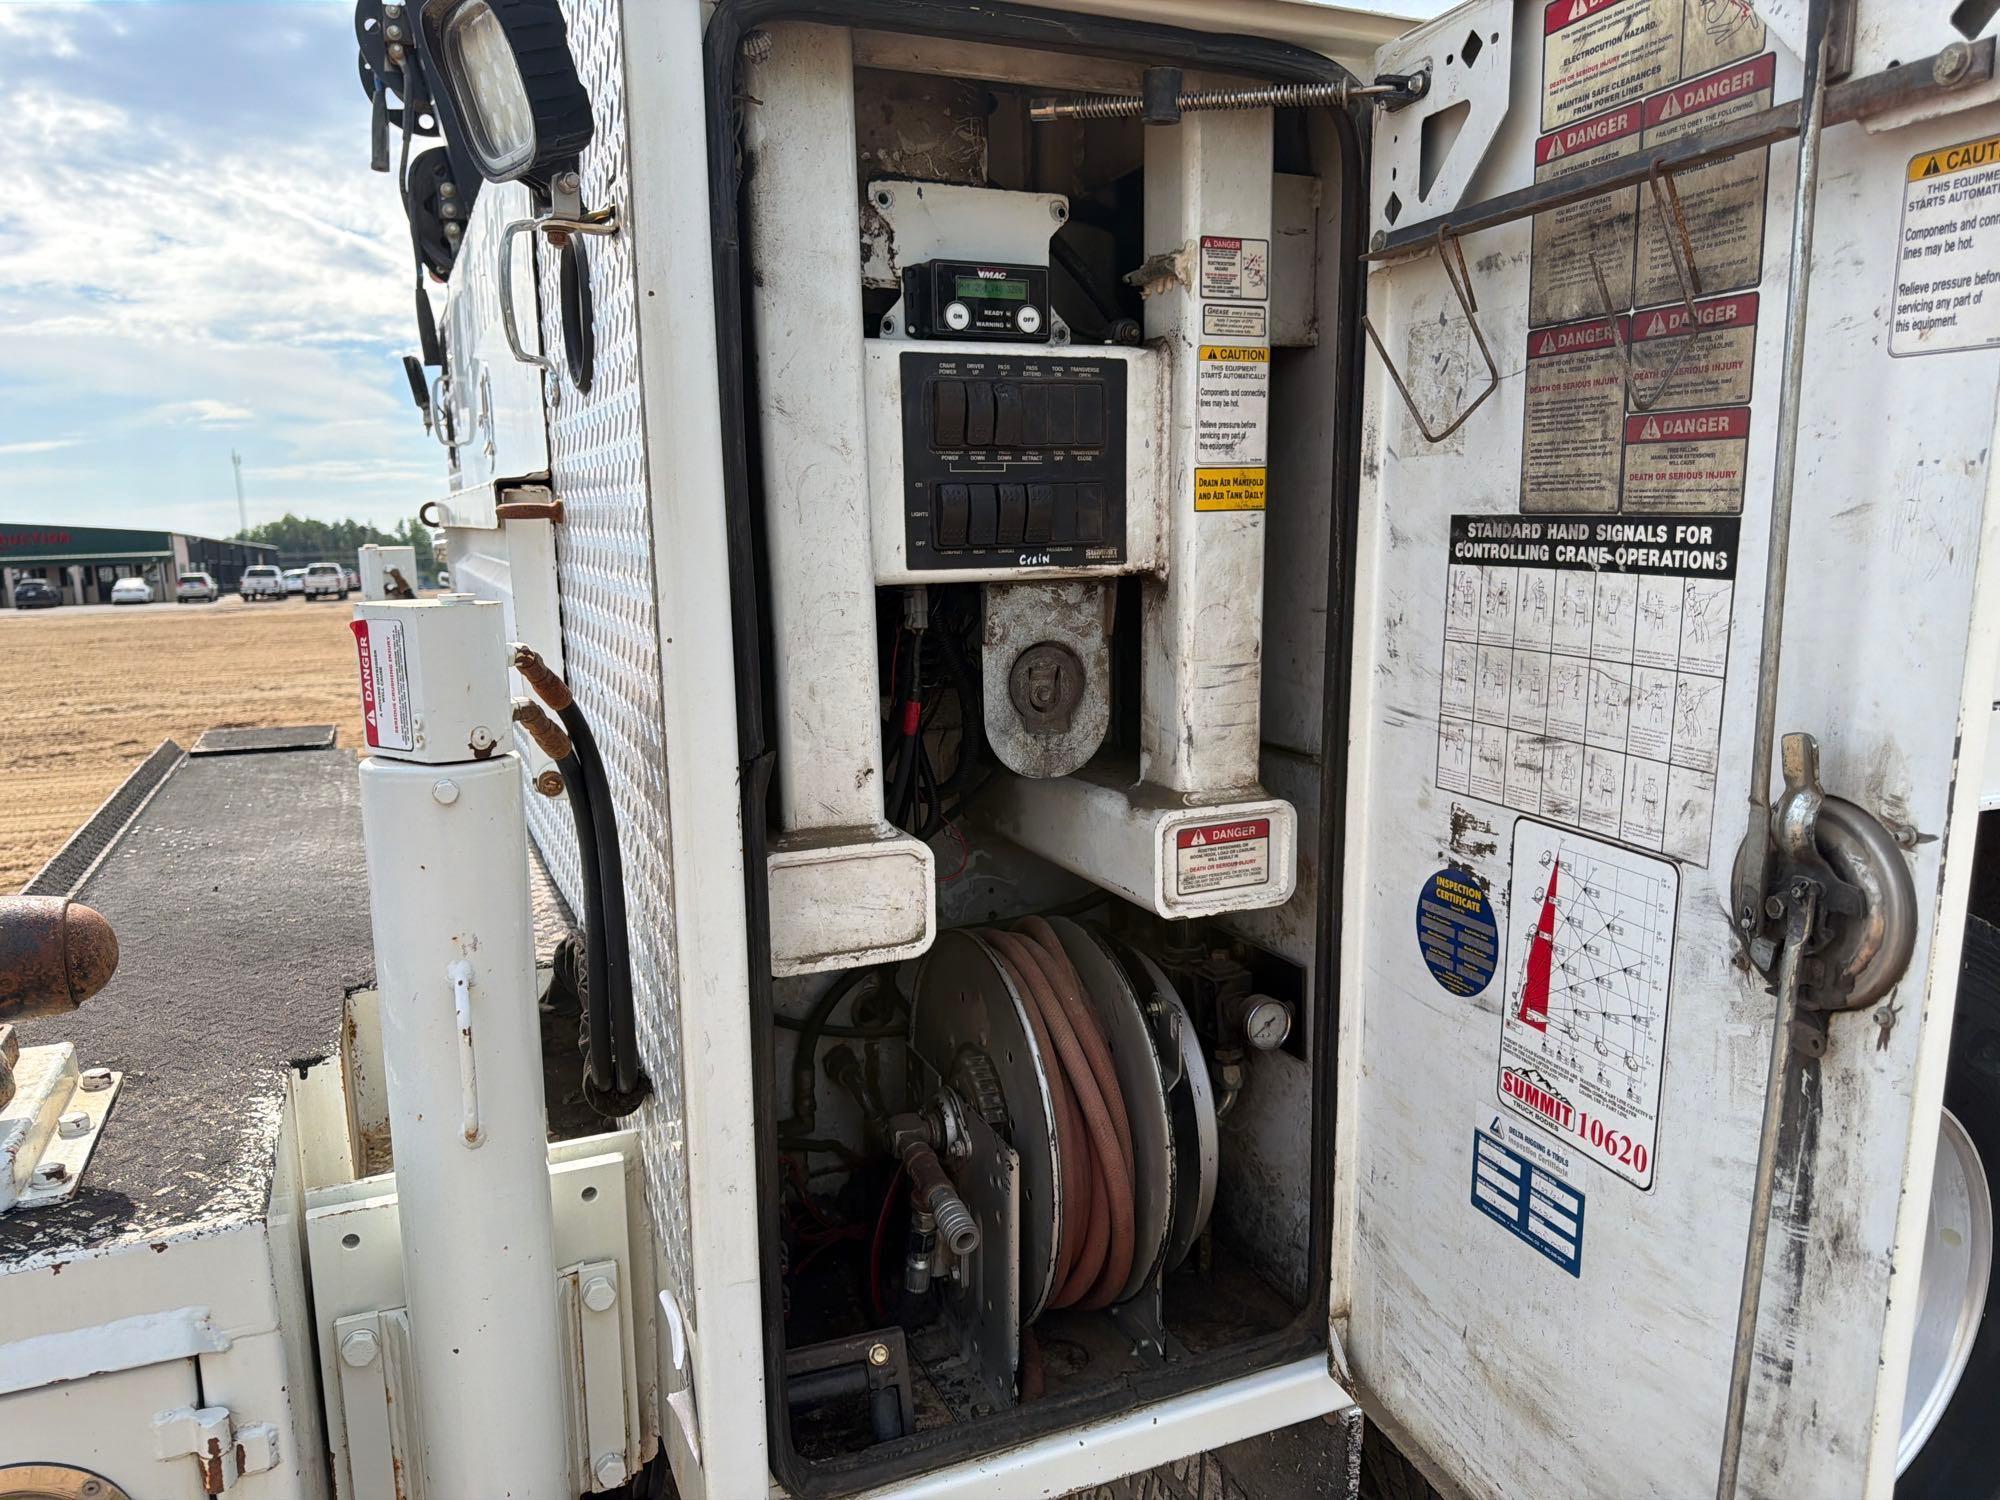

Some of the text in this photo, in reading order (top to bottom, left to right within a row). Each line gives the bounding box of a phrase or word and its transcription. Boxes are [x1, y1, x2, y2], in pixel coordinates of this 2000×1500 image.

[1563, 20, 1658, 66] ELECTROCUTION HAZARD.
[1549, 78, 1567, 90] DEATH
[1575, 64, 1599, 79] SERIOUS
[1599, 55, 1620, 69] INJURY
[1556, 64, 1662, 112] MAINTAIN SAFE CLEARANCES
[1683, 70, 1755, 110] DANGER
[1572, 82, 1644, 116] FROM POWER LINES
[1566, 113, 1629, 149] DANGER
[1655, 125, 1679, 140] FAILURE
[1704, 112, 1718, 124] THE
[1717, 101, 1754, 119] FOLLOWING
[1560, 150, 1620, 176] UNTRAINED OPERATOR
[1945, 140, 2000, 170] CAUT
[1927, 180, 1951, 195] THIS
[1908, 194, 1946, 213] STARTS
[1905, 215, 1978, 242] Components and
[1213, 241, 1241, 249] DANGER
[1903, 235, 1975, 261] lines may be hot.
[977, 270, 1007, 280] VMAC
[1898, 275, 1973, 297] Relieve pressure
[1207, 307, 1230, 316] GREASE
[1897, 289, 1984, 315] servicing any part of
[984, 309, 1004, 317] READY
[1895, 313, 1959, 333] this equipment.
[1558, 326, 1614, 349] DANGER
[1220, 348, 1265, 361] CAUTION
[1070, 366, 1100, 374] TRANSVERSE
[1210, 364, 1257, 372] THIS EQUIPMENT
[1222, 372, 1267, 380] AUTOMATICALLY
[1633, 369, 1659, 381] DEATH
[1711, 360, 1745, 372] INJURY
[1200, 387, 1267, 399] Components and connecting
[1529, 384, 1551, 395] DEATH
[1562, 379, 1592, 391] SERIOUS
[1593, 376, 1620, 387] INJURY
[1200, 399, 1240, 409] lines may be hot.
[1199, 419, 1257, 431] Relieve pressure before
[1199, 430, 1221, 440] servicing
[1220, 431, 1231, 440] any
[1230, 431, 1241, 440] part
[1663, 415, 1730, 435] DANGER
[1199, 442, 1209, 450] this
[1198, 477, 1264, 487] DRAIN AIR MANIFOLD
[1629, 470, 1738, 482] DEATH OR SERIOUS INJURY
[1198, 490, 1264, 500] AND AIR TANK DAILY
[1467, 522, 1713, 545] STANDARD HAND SIGNALS FOR
[1455, 541, 1728, 571] CONTROLLING CRANE OPERATIONS
[359, 636, 373, 702] DANGER
[388, 663, 397, 702] CRUSHING
[1212, 825, 1256, 841] DANGER
[1217, 843, 1242, 851] PERSONNEL
[1189, 865, 1206, 873] DEATH
[1215, 861, 1238, 870] SERIOUS
[1238, 859, 1257, 867] INJURY
[1436, 876, 1482, 901] INSPECTION
[1435, 888, 1481, 913] CERTIFICATE
[1502, 1070, 1573, 1128] SUMMIT
[1576, 1112, 1648, 1174] 10620
[1513, 1099, 1559, 1133] TRUCK BODIES
[1507, 1135, 1537, 1157] Inspection
[1508, 1126, 1524, 1142] DELTA
[1524, 1135, 1546, 1154] RIGGING
[1551, 1151, 1569, 1168] TOOLS
